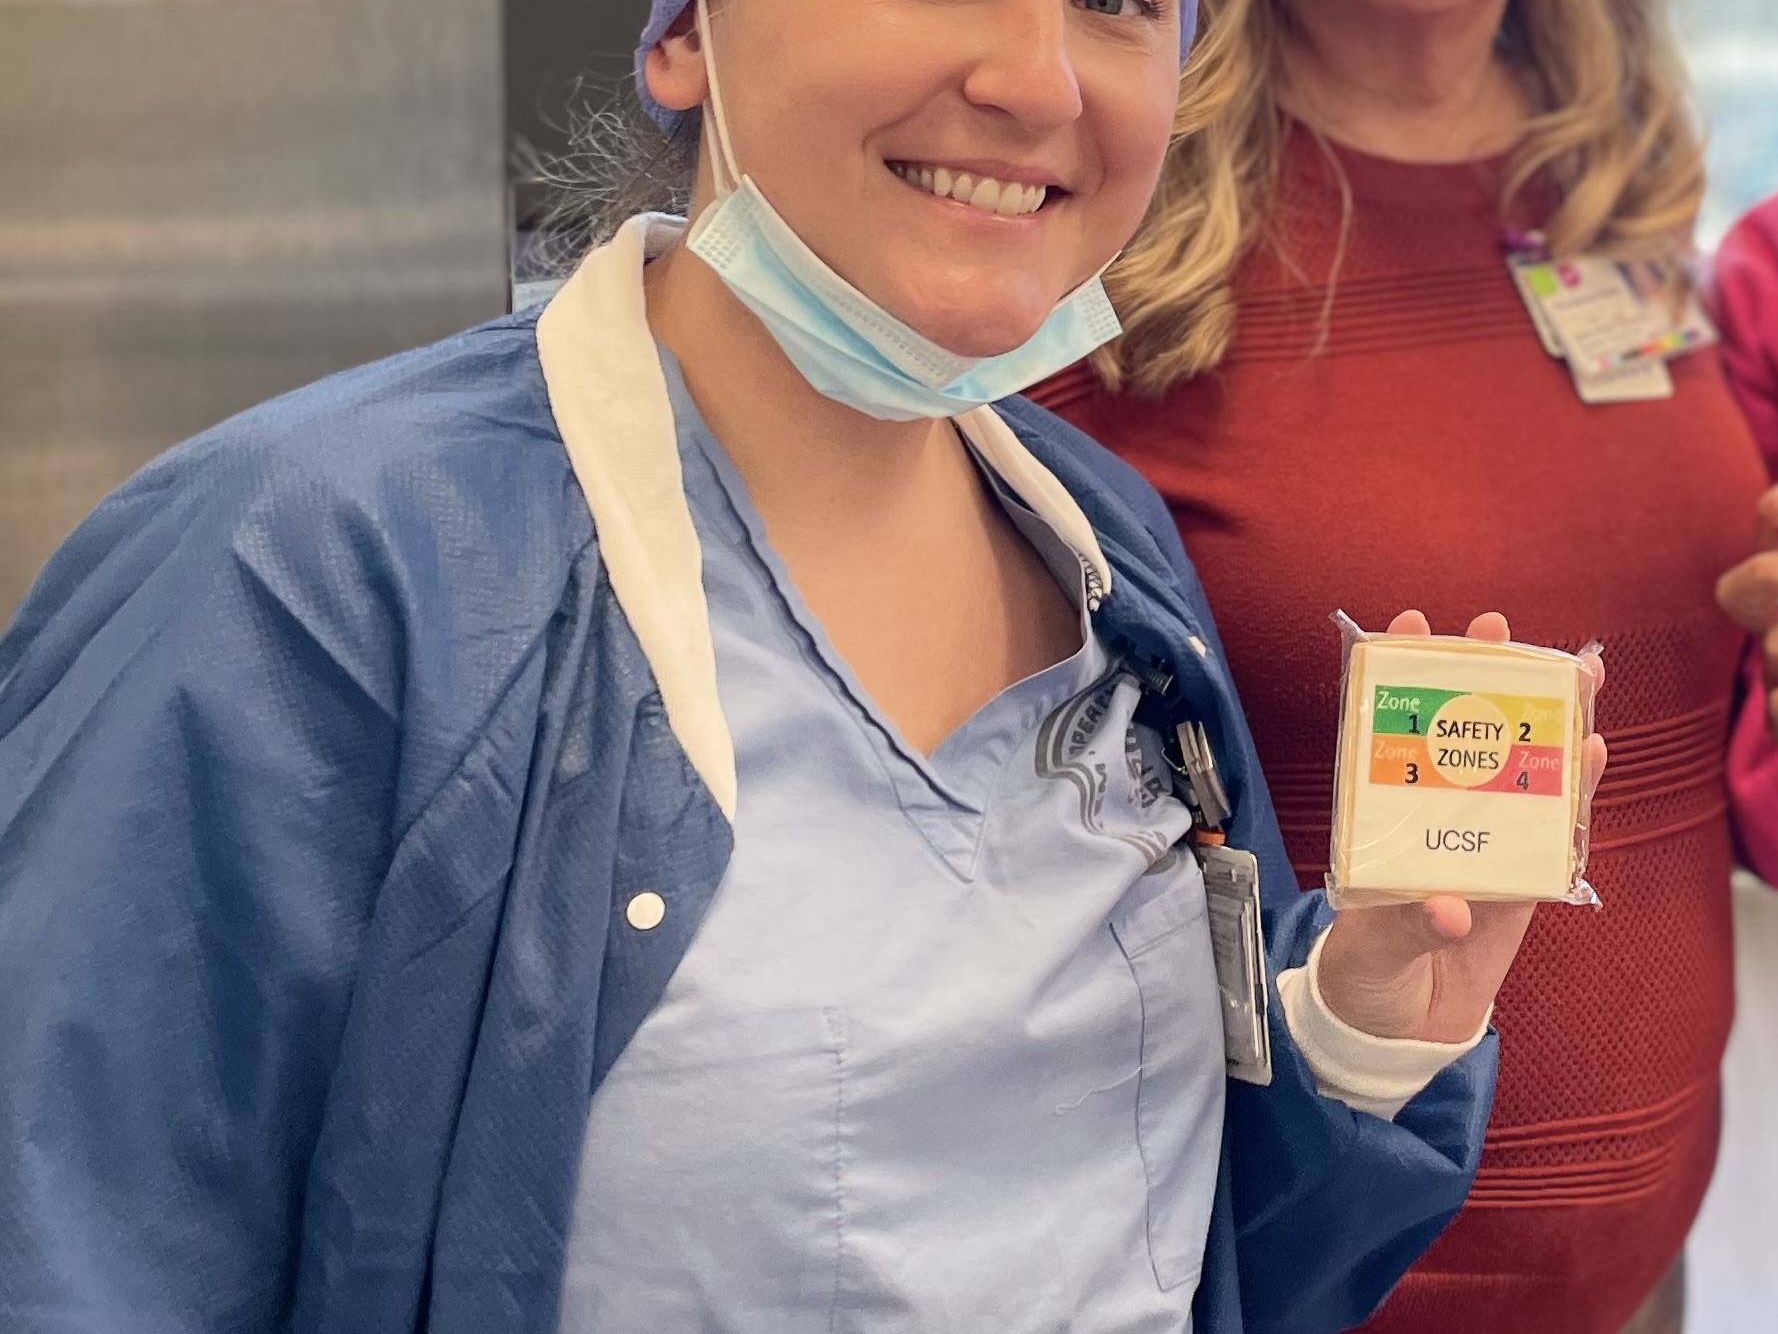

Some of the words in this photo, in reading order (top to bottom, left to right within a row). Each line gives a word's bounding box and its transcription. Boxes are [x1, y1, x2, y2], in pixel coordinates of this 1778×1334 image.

[1376, 690, 1422, 713] Zone
[1408, 713, 1421, 735] 1
[1436, 719, 1505, 742] SAFETY
[1518, 722, 1532, 743] 2
[1374, 740, 1418, 762] Zone
[1436, 748, 1500, 771] ZONES
[1518, 750, 1561, 771] Zone
[1403, 763, 1419, 785] 3
[1515, 770, 1530, 791] 4
[1425, 828, 1491, 854] UCSF
